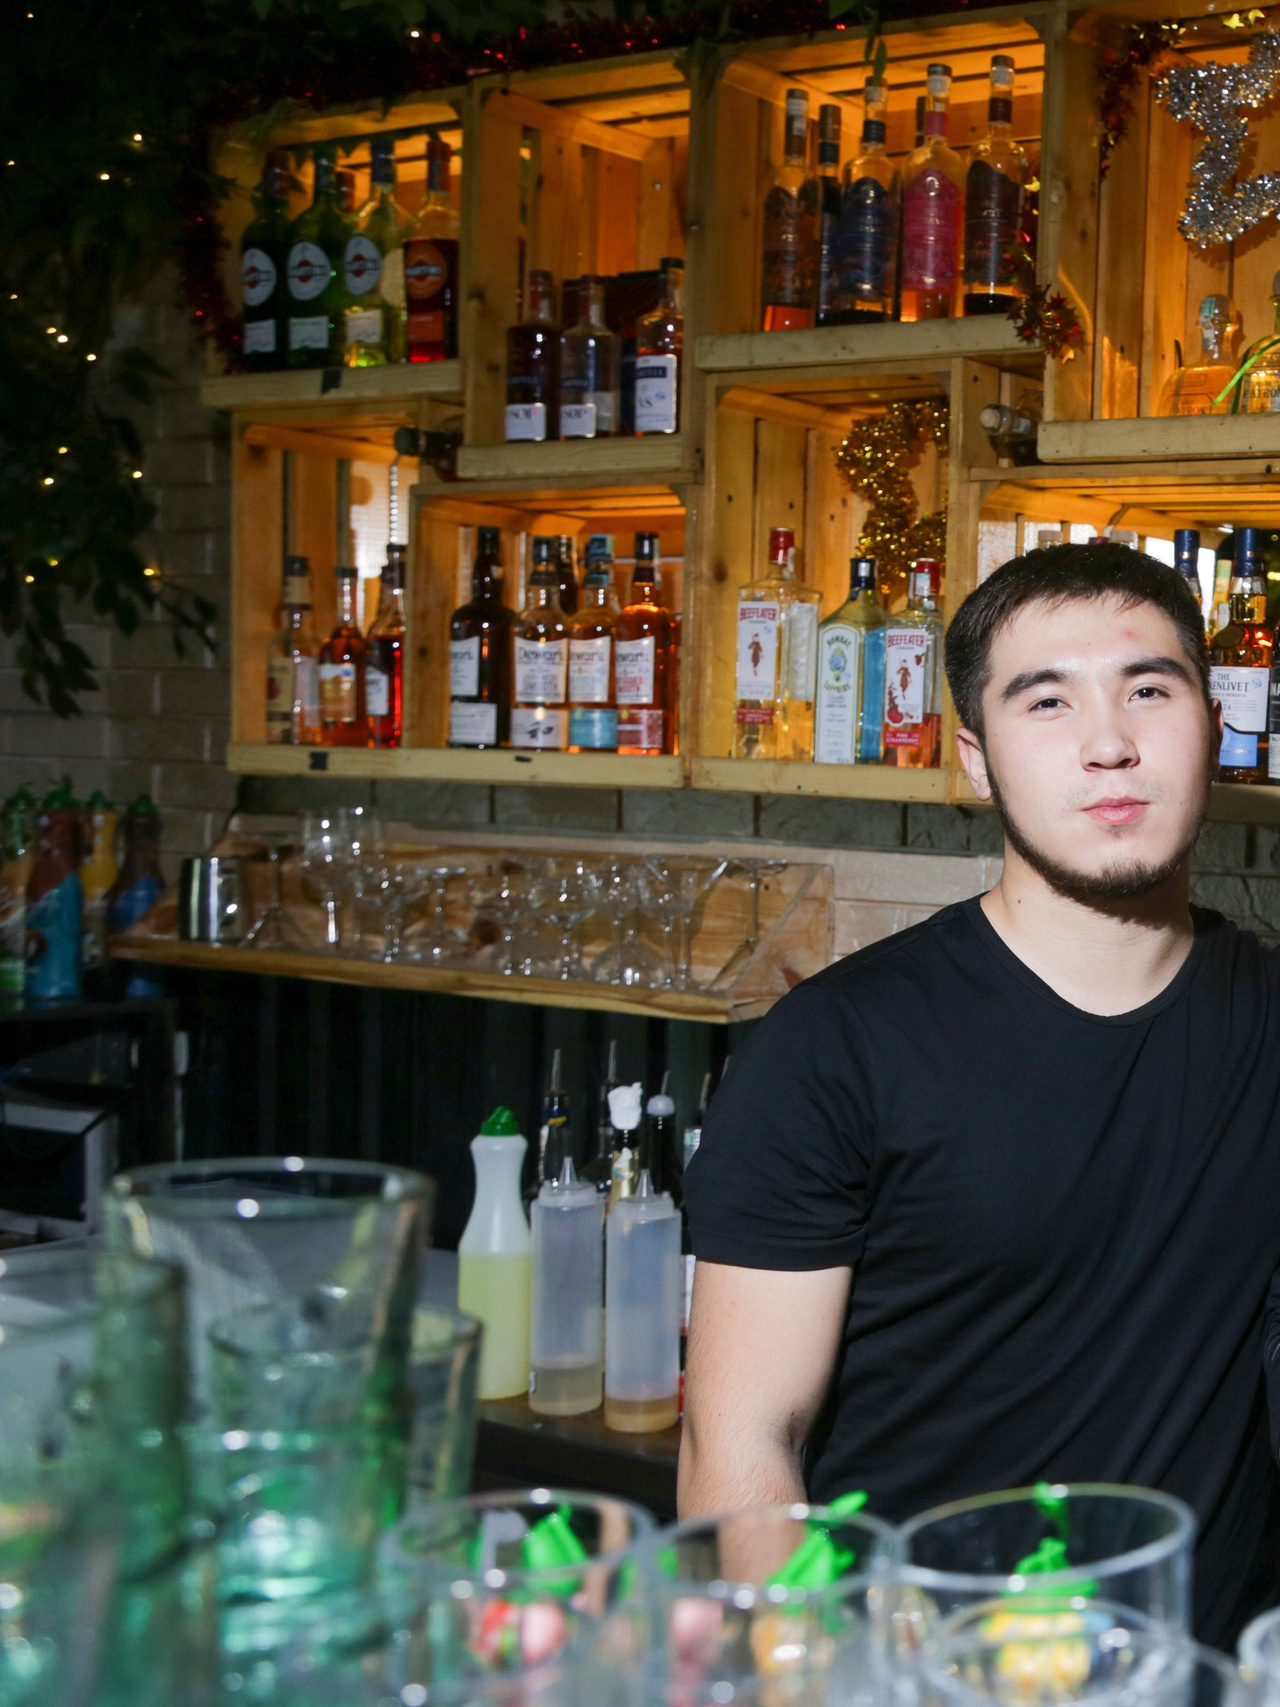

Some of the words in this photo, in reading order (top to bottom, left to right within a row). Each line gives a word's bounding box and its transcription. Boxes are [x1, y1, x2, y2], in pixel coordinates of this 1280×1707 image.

[740, 607, 777, 622] BEEFEATER
[887, 634, 925, 648] BEEFEATER
[1217, 673, 1231, 681] THE
